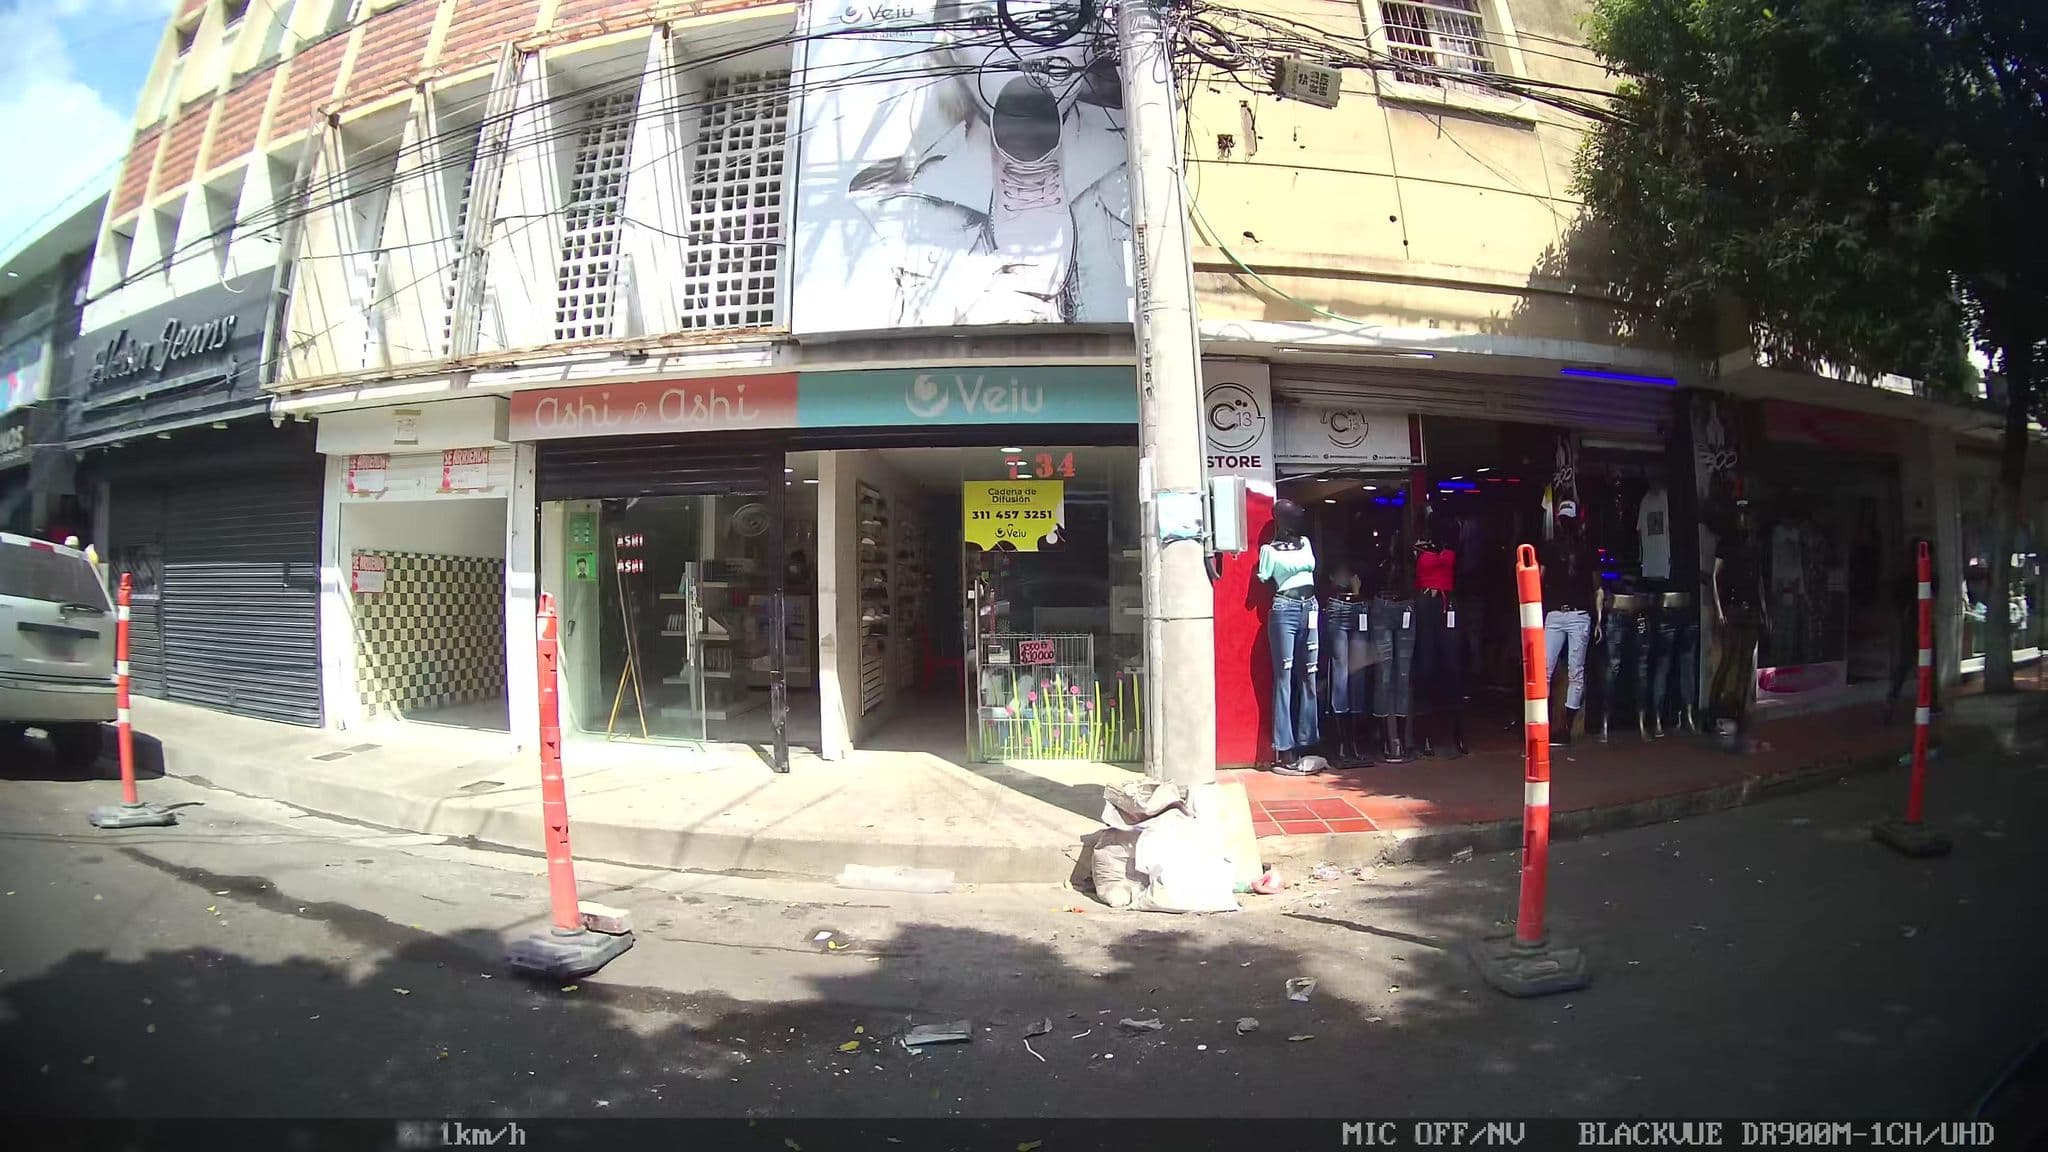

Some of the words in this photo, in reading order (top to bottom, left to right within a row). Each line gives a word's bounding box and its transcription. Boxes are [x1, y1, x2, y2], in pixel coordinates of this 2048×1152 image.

[868, 5, 914, 20] Veiu
[153, 315, 238, 372] Jeans
[955, 374, 1044, 415] Veiu
[1207, 455, 1262, 468] STORE
[988, 488, 1022, 496] Cadena
[1025, 488, 1037, 496] de
[992, 495, 1031, 504] Difusión
[972, 511, 990, 519] 311
[996, 511, 1019, 519] 457
[1024, 511, 1052, 519] 3251
[1007, 528, 1027, 538] Veiu
[617, 534, 643, 547] ASHI
[617, 559, 643, 573] ASHI
